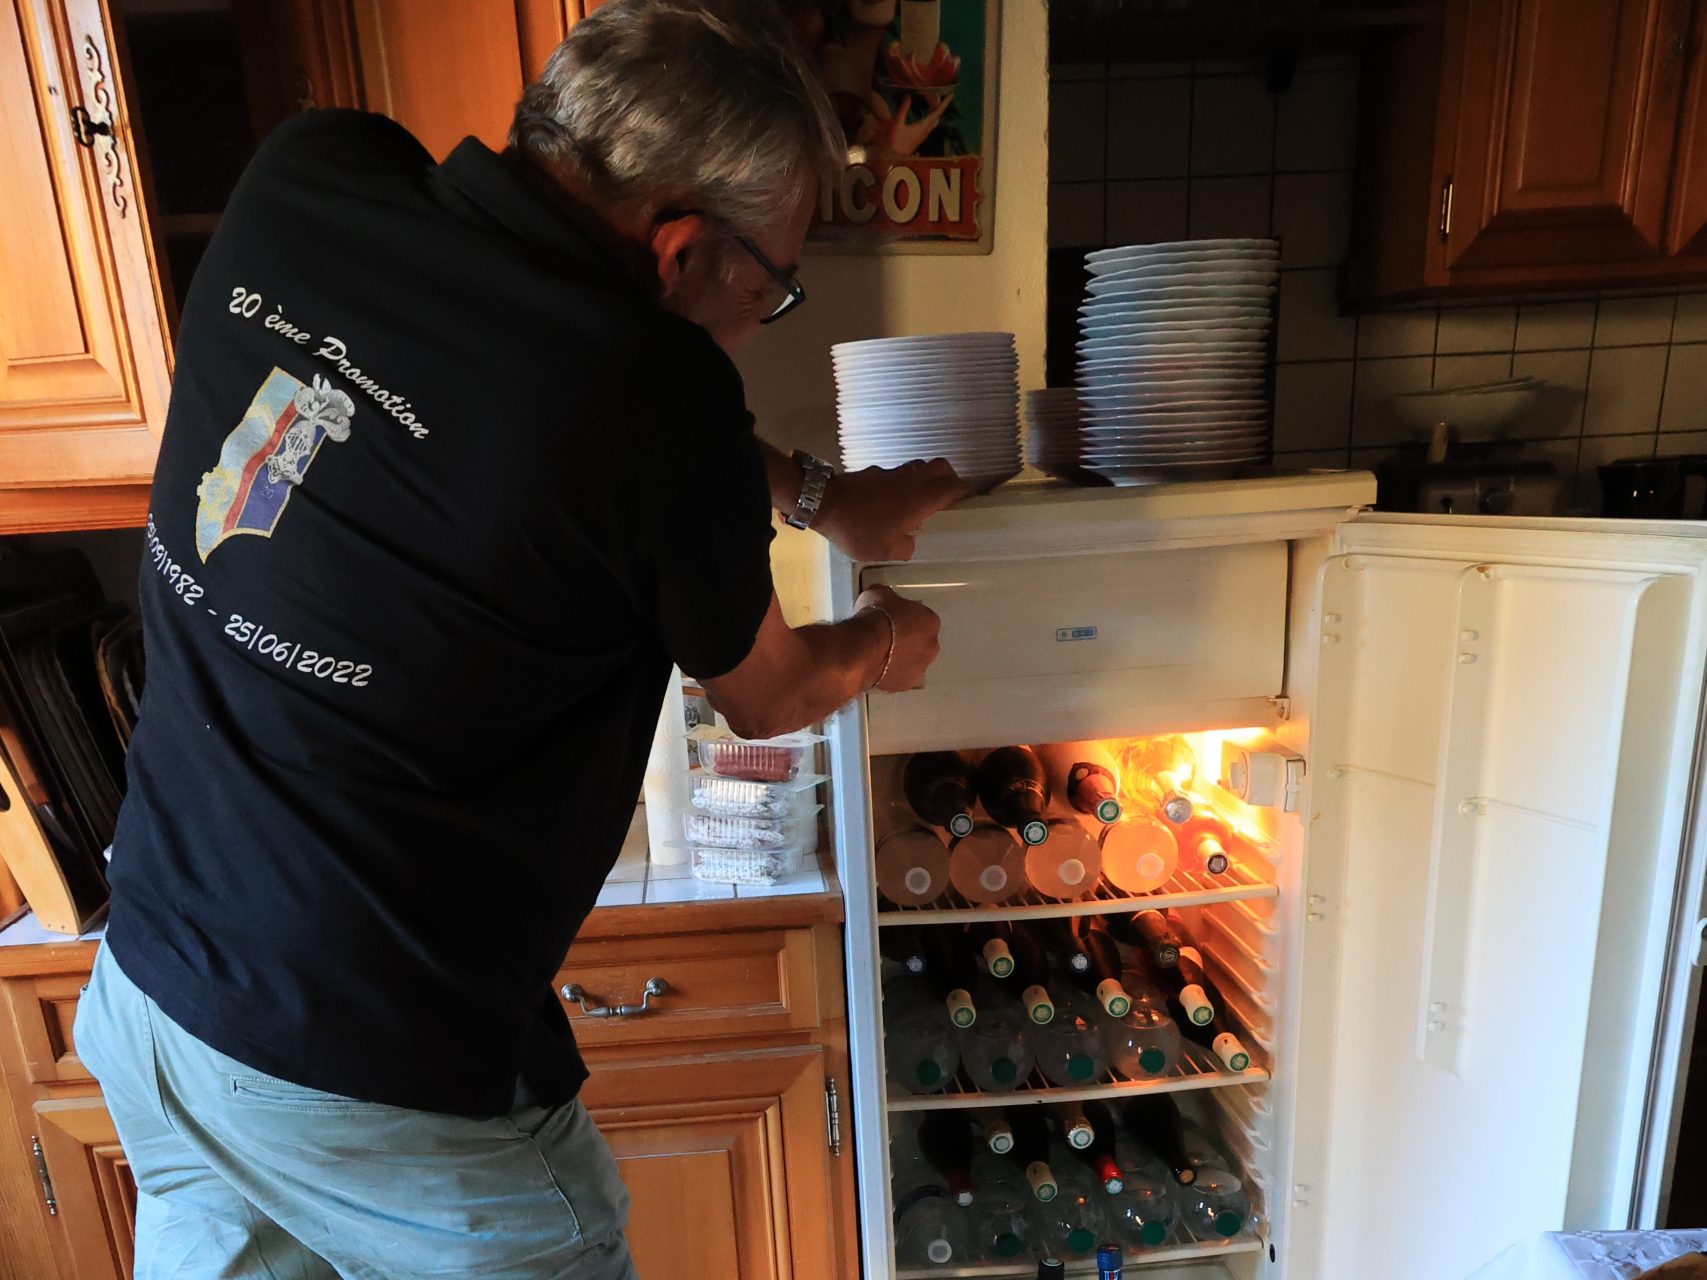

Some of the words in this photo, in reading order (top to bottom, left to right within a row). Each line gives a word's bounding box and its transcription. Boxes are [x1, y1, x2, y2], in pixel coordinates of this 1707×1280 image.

[820, 163, 962, 224] ICON
[229, 287, 262, 318] 20
[264, 304, 311, 344] ème
[312, 336, 429, 439] Promotion
[224, 613, 373, 687] 25/06/2022
